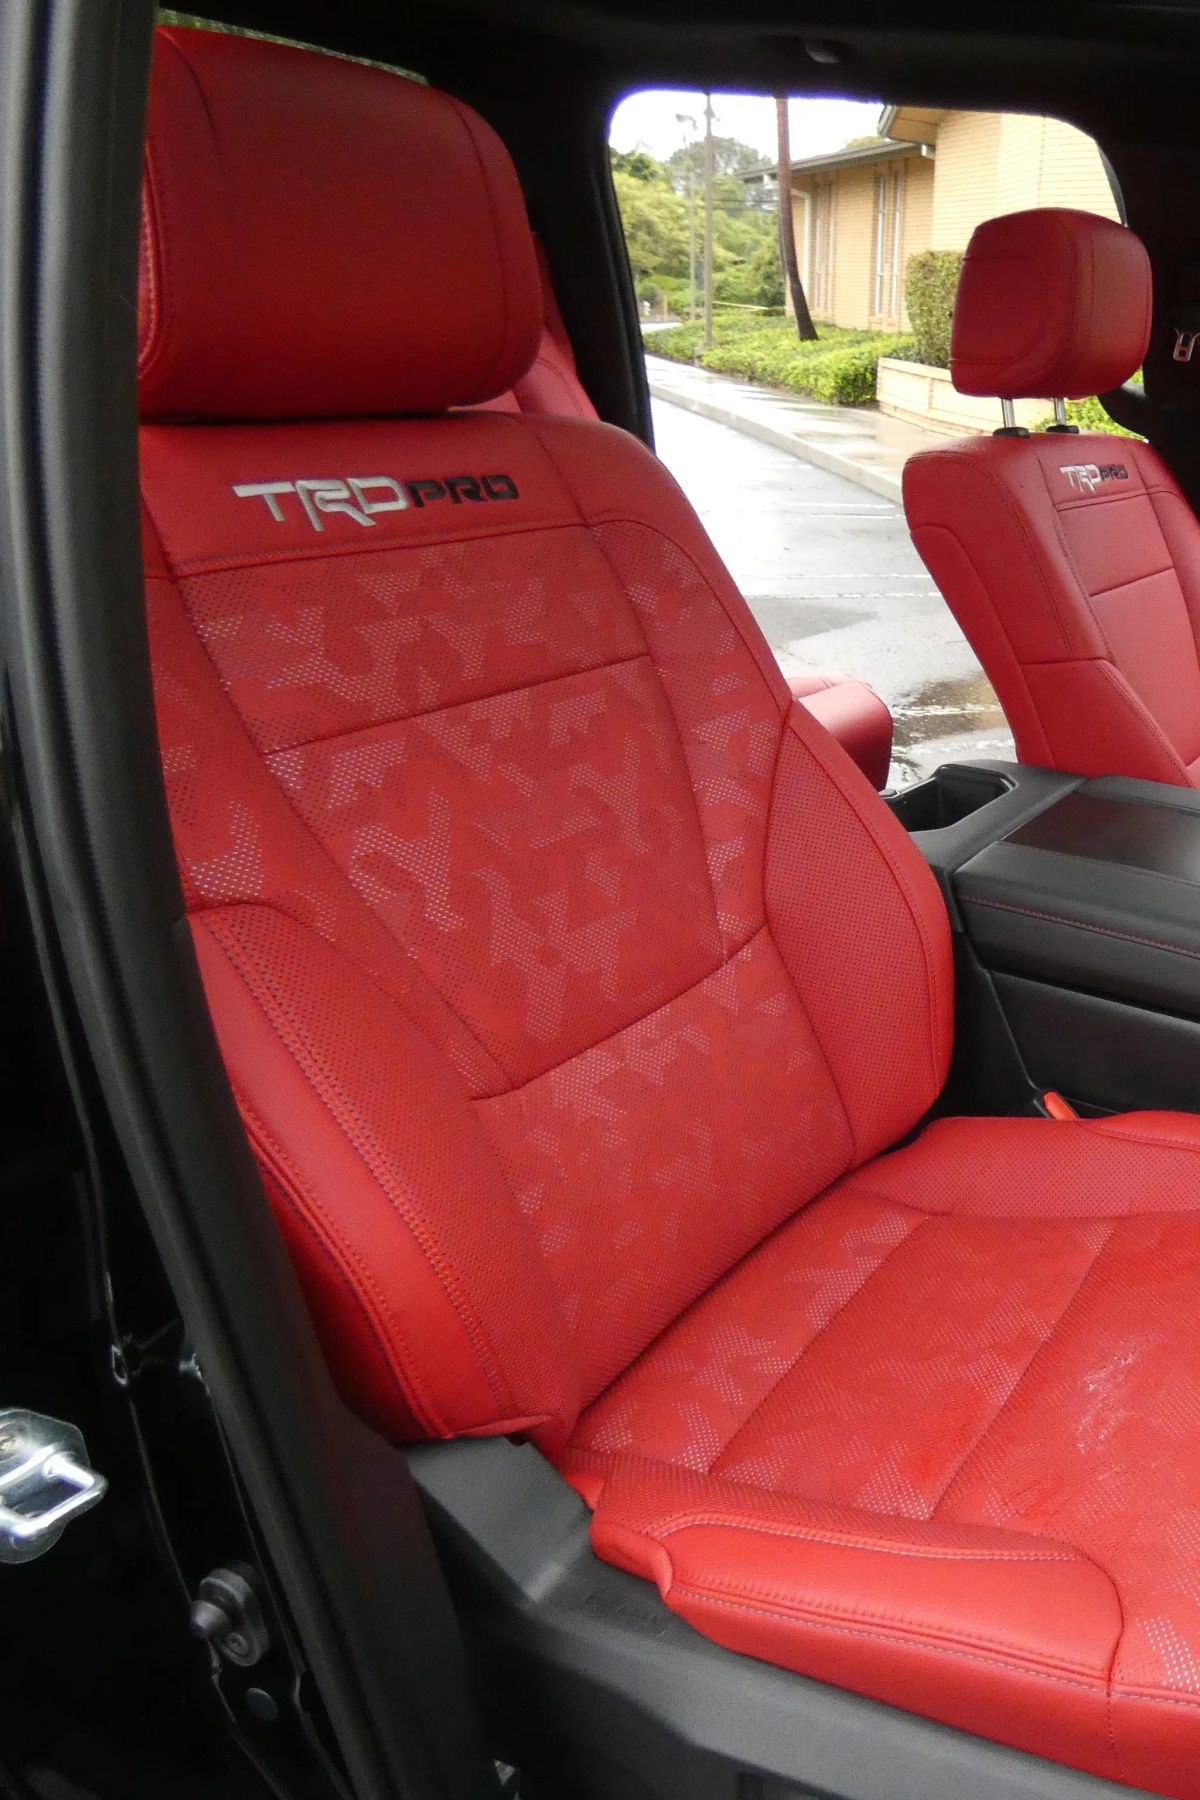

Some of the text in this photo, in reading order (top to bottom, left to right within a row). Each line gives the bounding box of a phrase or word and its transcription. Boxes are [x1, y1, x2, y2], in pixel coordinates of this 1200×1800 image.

[1059, 464, 1129, 493] TRD PRO
[231, 474, 520, 532] TRD PRO
